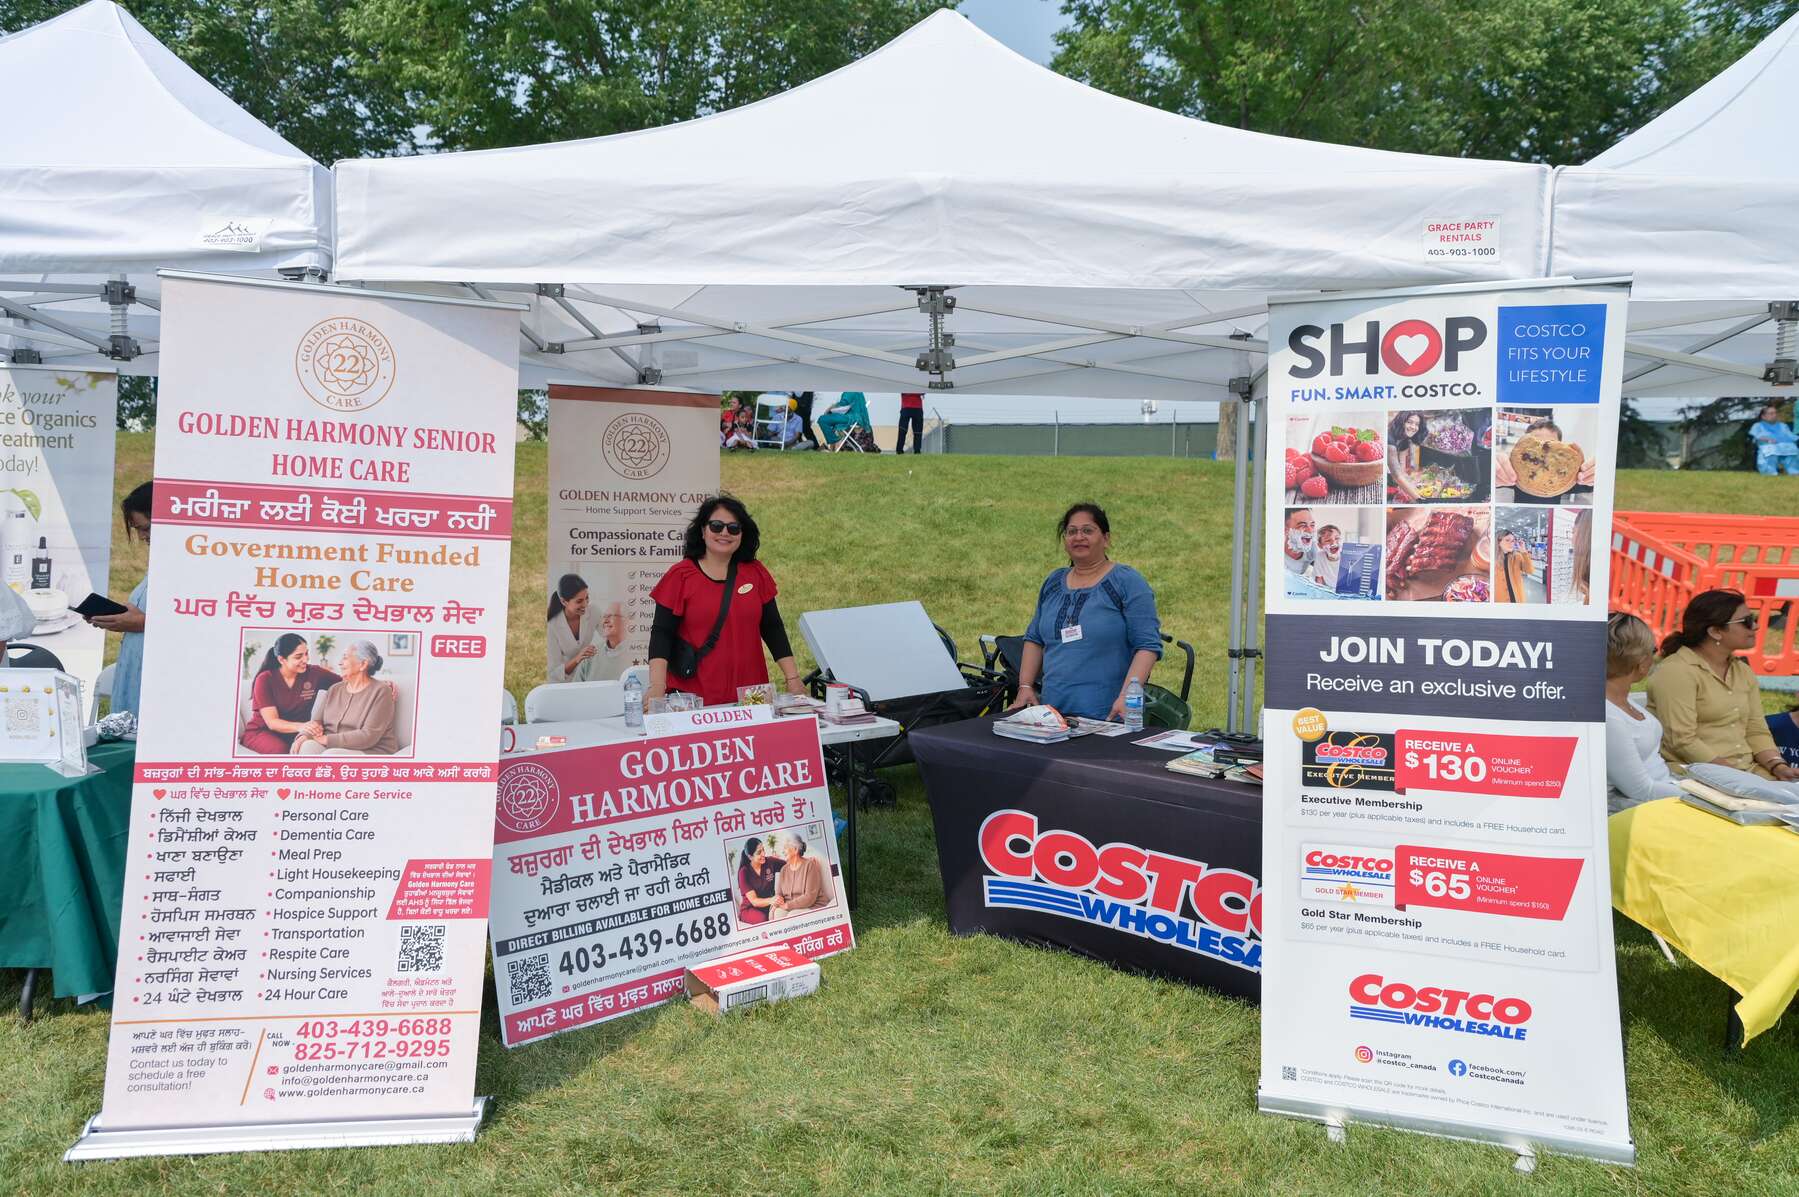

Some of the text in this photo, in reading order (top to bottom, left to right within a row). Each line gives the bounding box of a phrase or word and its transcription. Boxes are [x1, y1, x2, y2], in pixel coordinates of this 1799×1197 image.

[1464, 222, 1495, 230] PARTY
[1440, 234, 1482, 242] RENTALS
[1514, 324, 1586, 338] COSTCO
[301, 321, 391, 363] GOLDEN HARMONY
[1288, 316, 1488, 379] SHOP
[1508, 347, 1590, 360] FITS YOUR
[333, 353, 360, 373] 22
[1509, 369, 1587, 383] LIFESTYLE
[18, 388, 66, 410] your
[1291, 382, 1482, 402] FUN. SMART. COSTCO.
[326, 394, 363, 408] CARE
[22, 409, 96, 430] Organics
[178, 411, 496, 454] GOLDEN HARMONY SENIOR
[272, 453, 410, 483] HOME CARE
[559, 489, 610, 501] GOLDEN
[613, 491, 676, 503] HARMONY
[259, 494, 312, 522] ਲਈ
[321, 495, 366, 525] ਕੋਈ
[375, 506, 439, 528] ਖਰਚਾ
[448, 503, 497, 531] ਨਹੀਂ
[585, 506, 682, 516] Home Support Services
[569, 527, 665, 541] Compassionate
[185, 534, 480, 566] Government Funded
[570, 544, 588, 555] for
[591, 544, 636, 556] Seniors
[639, 546, 647, 555] &
[253, 566, 414, 593] Home Care
[174, 597, 218, 617] ਘਰ
[353, 597, 434, 623] ਦੇਖਭਾਲ
[442, 600, 485, 625] ਸੇਵਾ
[435, 640, 482, 654] FREE
[1320, 636, 1553, 669] JOIN TODAY!
[1307, 673, 1566, 700] Receive an exclusive offer.
[691, 709, 753, 726] GOLDEN
[1297, 715, 1320, 725] BEST
[1296, 723, 1324, 734] VALUE
[1315, 742, 1387, 759] COSTCO
[1405, 739, 1475, 753] RECEIVE A
[619, 736, 756, 780] GOLDEN
[1491, 757, 1521, 766] ONLINE
[1404, 751, 1487, 782] $130
[294, 788, 412, 800] In-Home Care Service
[569, 759, 812, 824] HARMONY CARE
[1301, 795, 1423, 811] Executive Membership
[282, 810, 369, 822] Personal Care
[280, 828, 375, 841] Dementia Care
[580, 834, 601, 860] ਦੀ
[607, 828, 666, 855] ਦੇਖਭਾਲ
[714, 808, 745, 835] ਕਿਸੇ
[751, 802, 785, 827] ਖਰਚੇ
[279, 849, 342, 861] Meal Prep
[1306, 851, 1394, 872] COSTCO
[1409, 856, 1480, 872] RECEIVE A
[277, 869, 308, 882] Light
[312, 867, 400, 880] Housekeeping
[540, 871, 594, 896] ਮੈਡੀਕਲ
[600, 863, 623, 882] ਅਤੇ
[978, 808, 1263, 938] COSTC
[1331, 868, 1391, 880] WHOLESALE
[1476, 876, 1506, 885] ONLINE
[1408, 869, 1471, 900] $65
[275, 887, 376, 901] Companionship
[576, 887, 620, 912] ਚਲਾਈ
[624, 887, 639, 901] ਜਾ
[645, 876, 670, 897] ਰਹੀ
[273, 907, 378, 922] Hospice Support
[508, 892, 727, 951] DIRECT BILLING AVAILABLE FOR HOME CARE
[1301, 908, 1422, 929] Gold Star Membership
[272, 927, 365, 942] Transportation
[558, 912, 731, 976] 403-439-6688
[269, 947, 350, 962] Respite Care
[267, 967, 372, 982] Nursing Services
[265, 988, 348, 1001] 24 Hour Care
[1349, 974, 1532, 1024] COSTCO
[296, 1018, 452, 1039] 403-439-6688
[1402, 1012, 1527, 1041] WHOLESALE
[294, 1039, 450, 1060] 825-712-9295
[1376, 1050, 1412, 1060] Instagram
[129, 1057, 228, 1069] Contact us today to
[283, 1060, 448, 1074] goldenharmonycare@gmail.com
[1469, 1063, 1526, 1077] facebook.com/
[128, 1069, 206, 1081] schedule a free
[281, 1073, 429, 1086] info@goldenharmonycare.ca
[1469, 1072, 1524, 1085] CostcoCanada
[127, 1081, 192, 1092] consultation!
[278, 1085, 425, 1098] www.goldenharmonycare.ca
